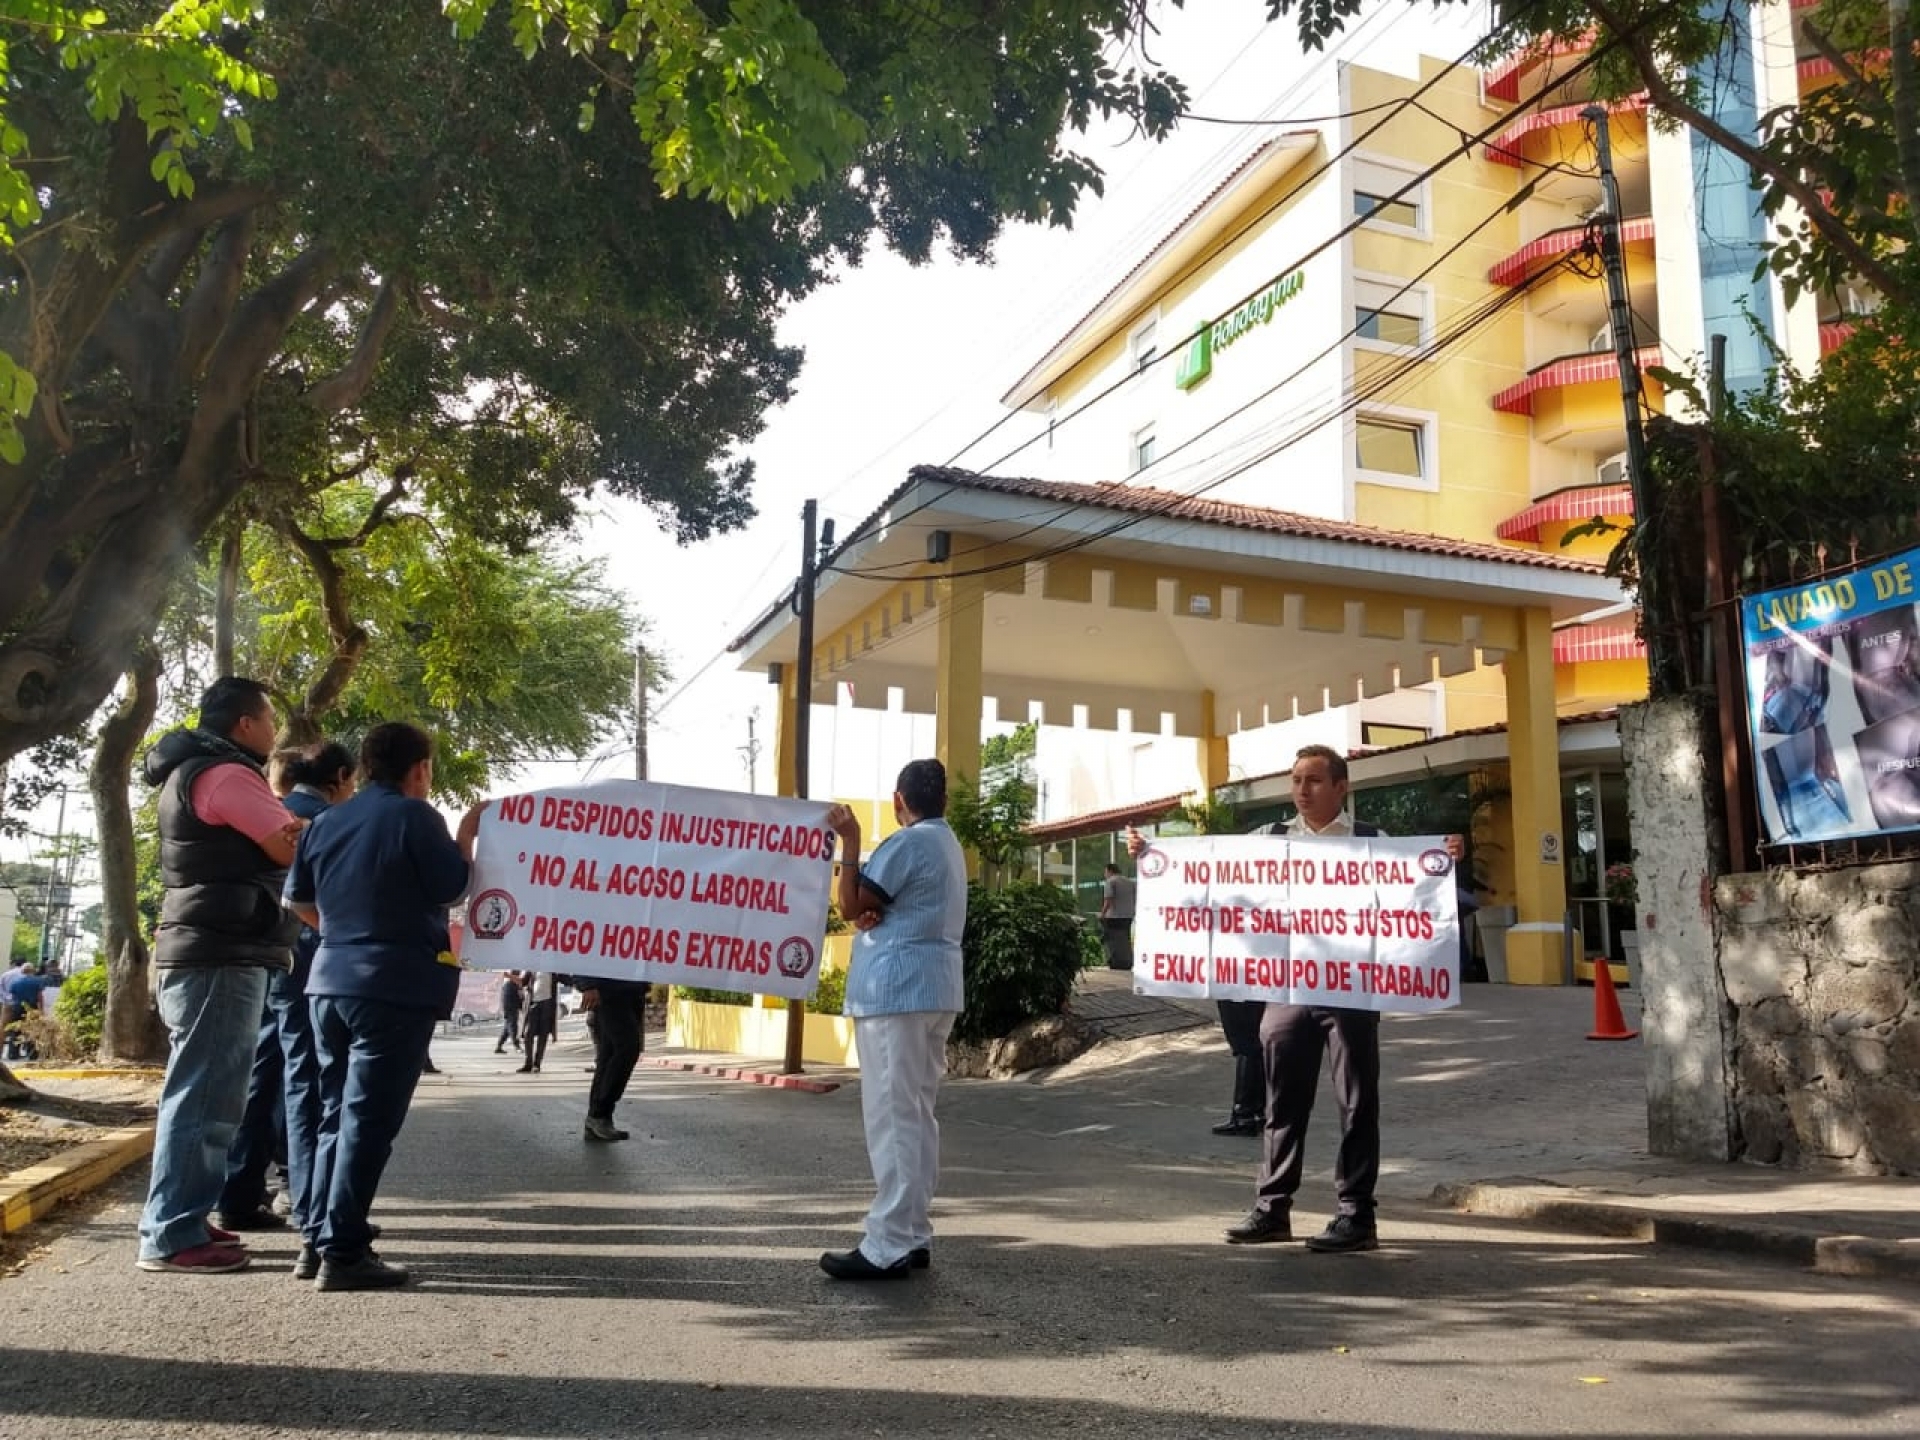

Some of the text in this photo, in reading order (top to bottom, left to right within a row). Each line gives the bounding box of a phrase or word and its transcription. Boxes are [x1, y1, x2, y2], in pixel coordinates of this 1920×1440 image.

[1211, 293, 1274, 353] Holiday
[1756, 562, 1914, 631] LAVADO DE
[1861, 630, 1902, 649] ANTES
[501, 796, 835, 861] NO DESPIDOS INJUSTIFICADOS
[531, 855, 788, 913] NO AL ACOSO LABORAL
[1185, 860, 1414, 886] NO MALTRATO LABORAL
[531, 917, 771, 975] PAGO HORAS EXTRAS
[1165, 906, 1434, 940] PAGO DE SALARIOS JUSTOS
[1215, 958, 1238, 983] MI
[1244, 958, 1319, 990] EQUIPO
[1325, 961, 1352, 991] DE
[1357, 962, 1450, 1000] TRABAJO
